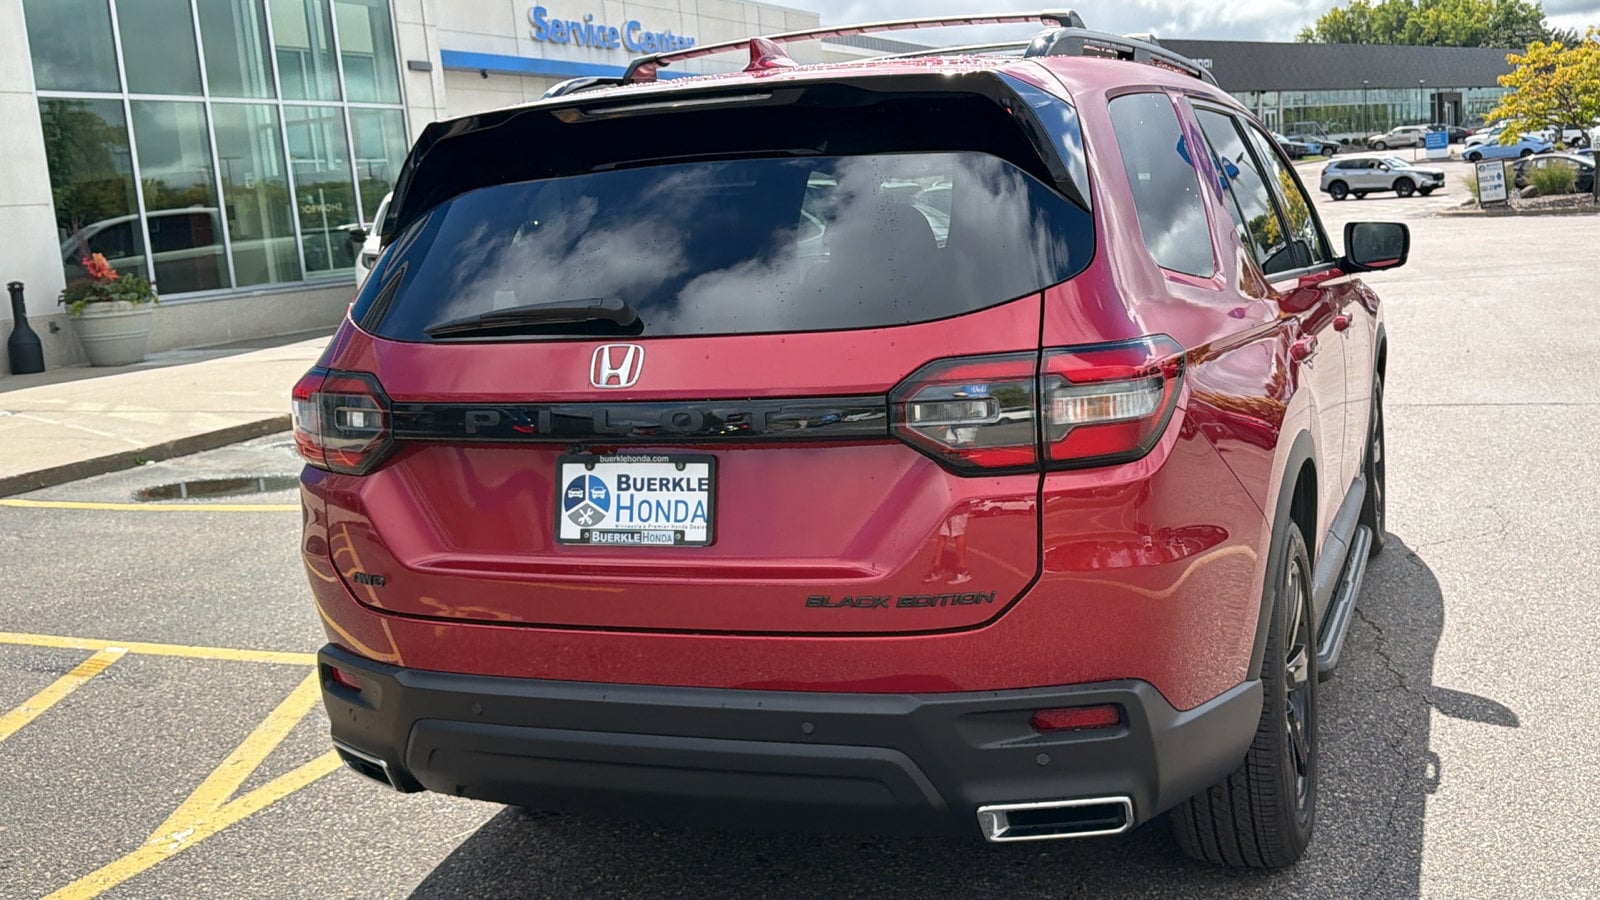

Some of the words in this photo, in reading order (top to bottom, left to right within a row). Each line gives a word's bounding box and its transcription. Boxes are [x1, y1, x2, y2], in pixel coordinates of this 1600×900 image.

[529, 6, 621, 49] Service
[464, 406, 783, 434] PILOT
[599, 455, 669, 463] buerklehonda.com
[617, 474, 708, 492] BUERKLE
[615, 494, 707, 523] HONDA
[353, 571, 385, 587] AWD
[805, 595, 891, 609] BLACK
[896, 590, 996, 609] EDITION
